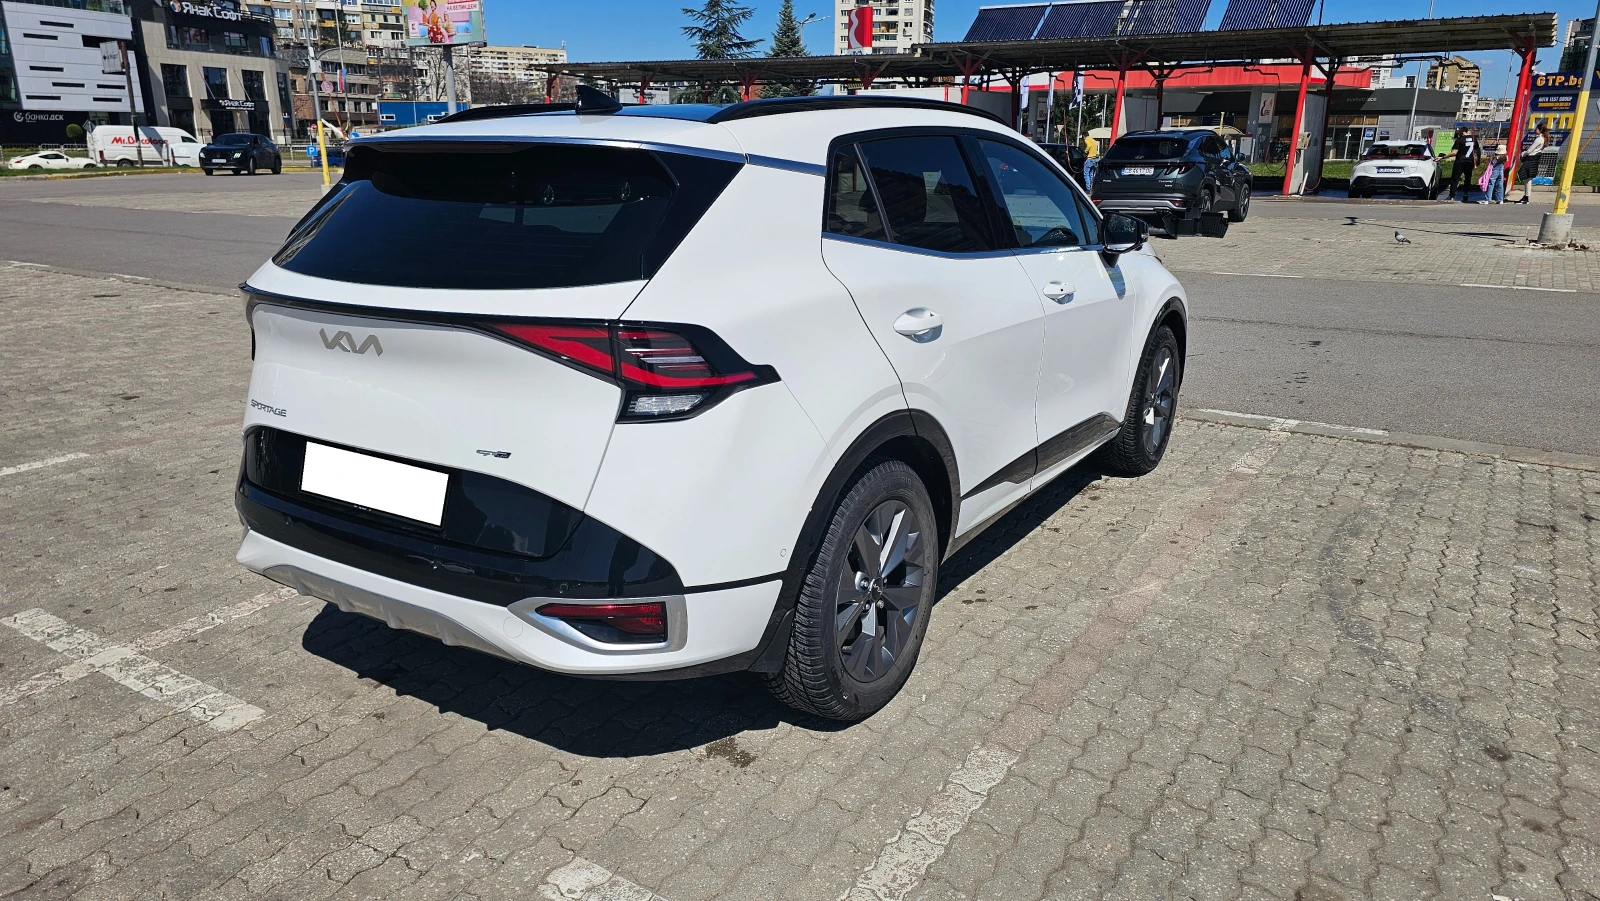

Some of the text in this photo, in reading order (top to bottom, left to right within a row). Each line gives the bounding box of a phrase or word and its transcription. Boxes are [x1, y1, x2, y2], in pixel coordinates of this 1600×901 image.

[213, 7, 243, 21] Софт
[1528, 113, 1575, 129] ГТП
[1465, 142, 1475, 158] 7
[319, 328, 383, 357] KIA
[250, 399, 287, 418] SPORTAGE
